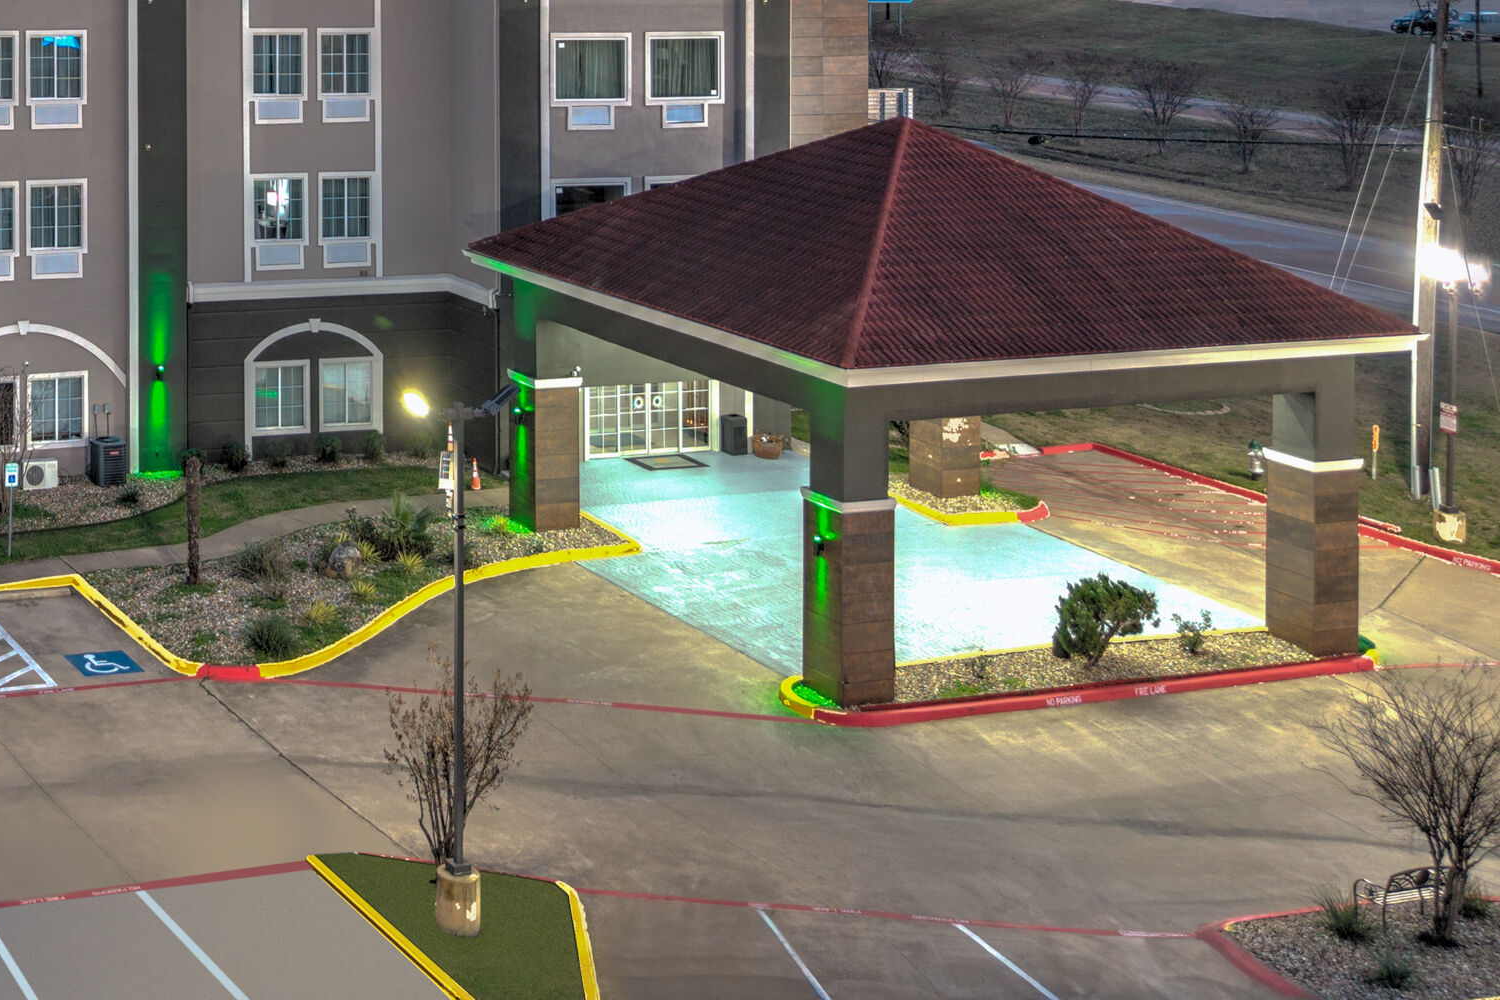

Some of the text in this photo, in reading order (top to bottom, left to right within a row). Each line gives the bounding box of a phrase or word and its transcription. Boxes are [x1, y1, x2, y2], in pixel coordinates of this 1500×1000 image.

[1134, 685, 1167, 696] FIRE LANE
[1046, 695, 1082, 706] NO PARKING
